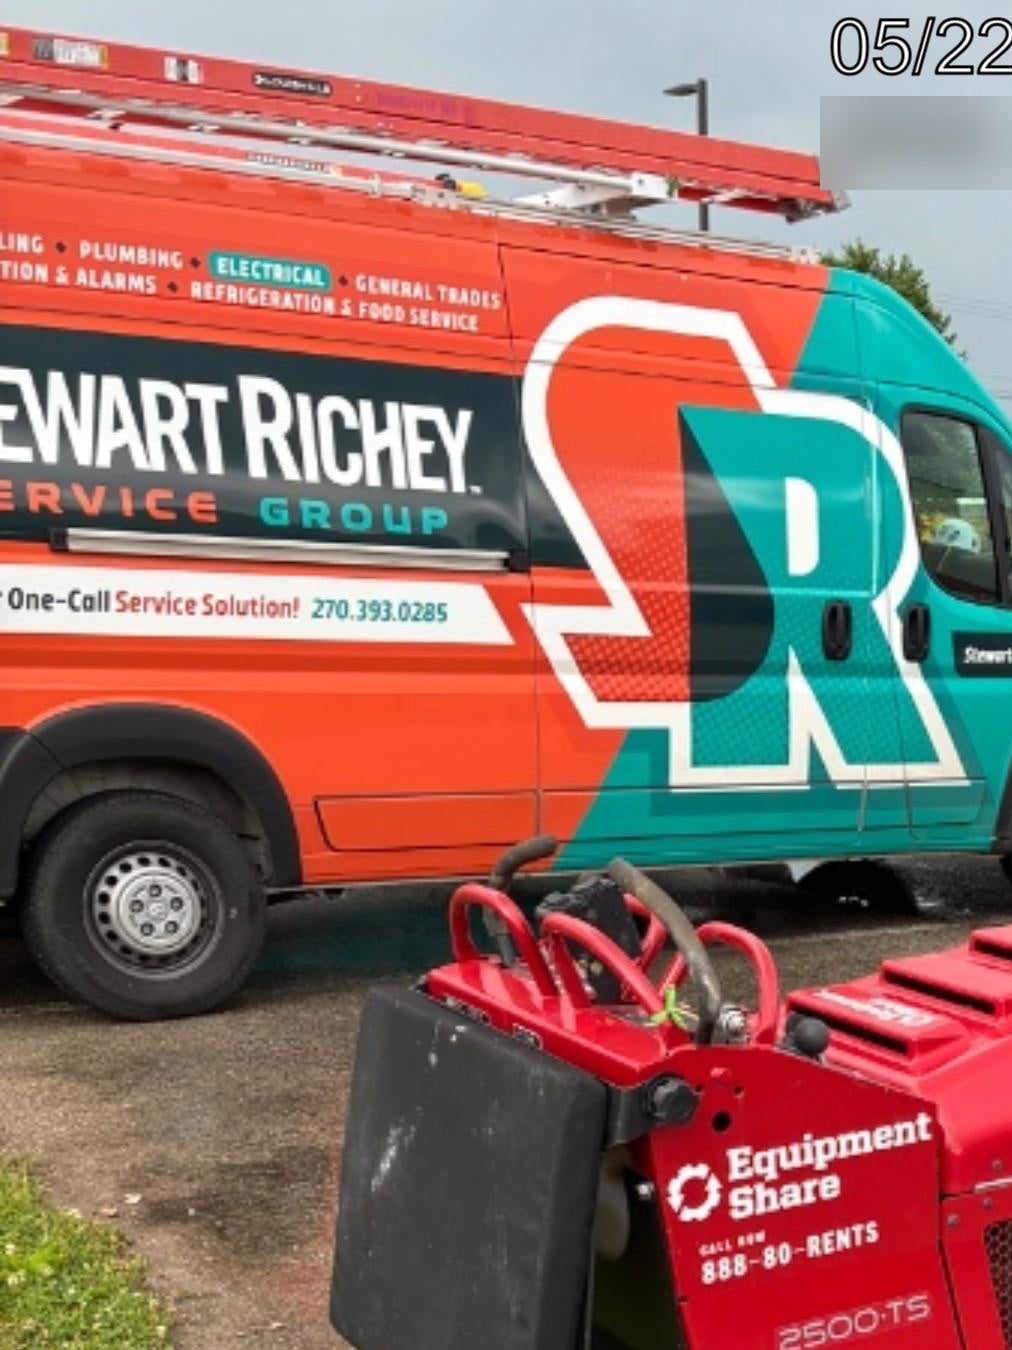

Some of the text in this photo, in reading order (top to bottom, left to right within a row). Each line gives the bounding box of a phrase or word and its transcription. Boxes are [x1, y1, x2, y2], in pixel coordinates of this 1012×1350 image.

[55, 265, 68, 286] &
[76, 268, 157, 295] ALARMS
[190, 280, 336, 316] REFRIGERATION
[340, 298, 352, 316] &
[359, 301, 406, 323] FOOD
[409, 308, 479, 332] SERVICE
[79, 240, 183, 270] PLUMBING
[216, 257, 326, 287] ELECTRICAL
[355, 274, 433, 302] GENERAL
[437, 284, 501, 310] TRADES
[236, 375, 475, 494] RICHEY
[259, 496, 450, 535] GROUP
[8, 587, 111, 613] One-Call
[115, 590, 198, 616] Service
[202, 593, 300, 619] Solution!
[310, 597, 449, 623] 270.393.0285
[726, 1112, 933, 1181] Equipment
[729, 1174, 842, 1220] Share
[701, 1220, 880, 1285] 888-80-RENTS
